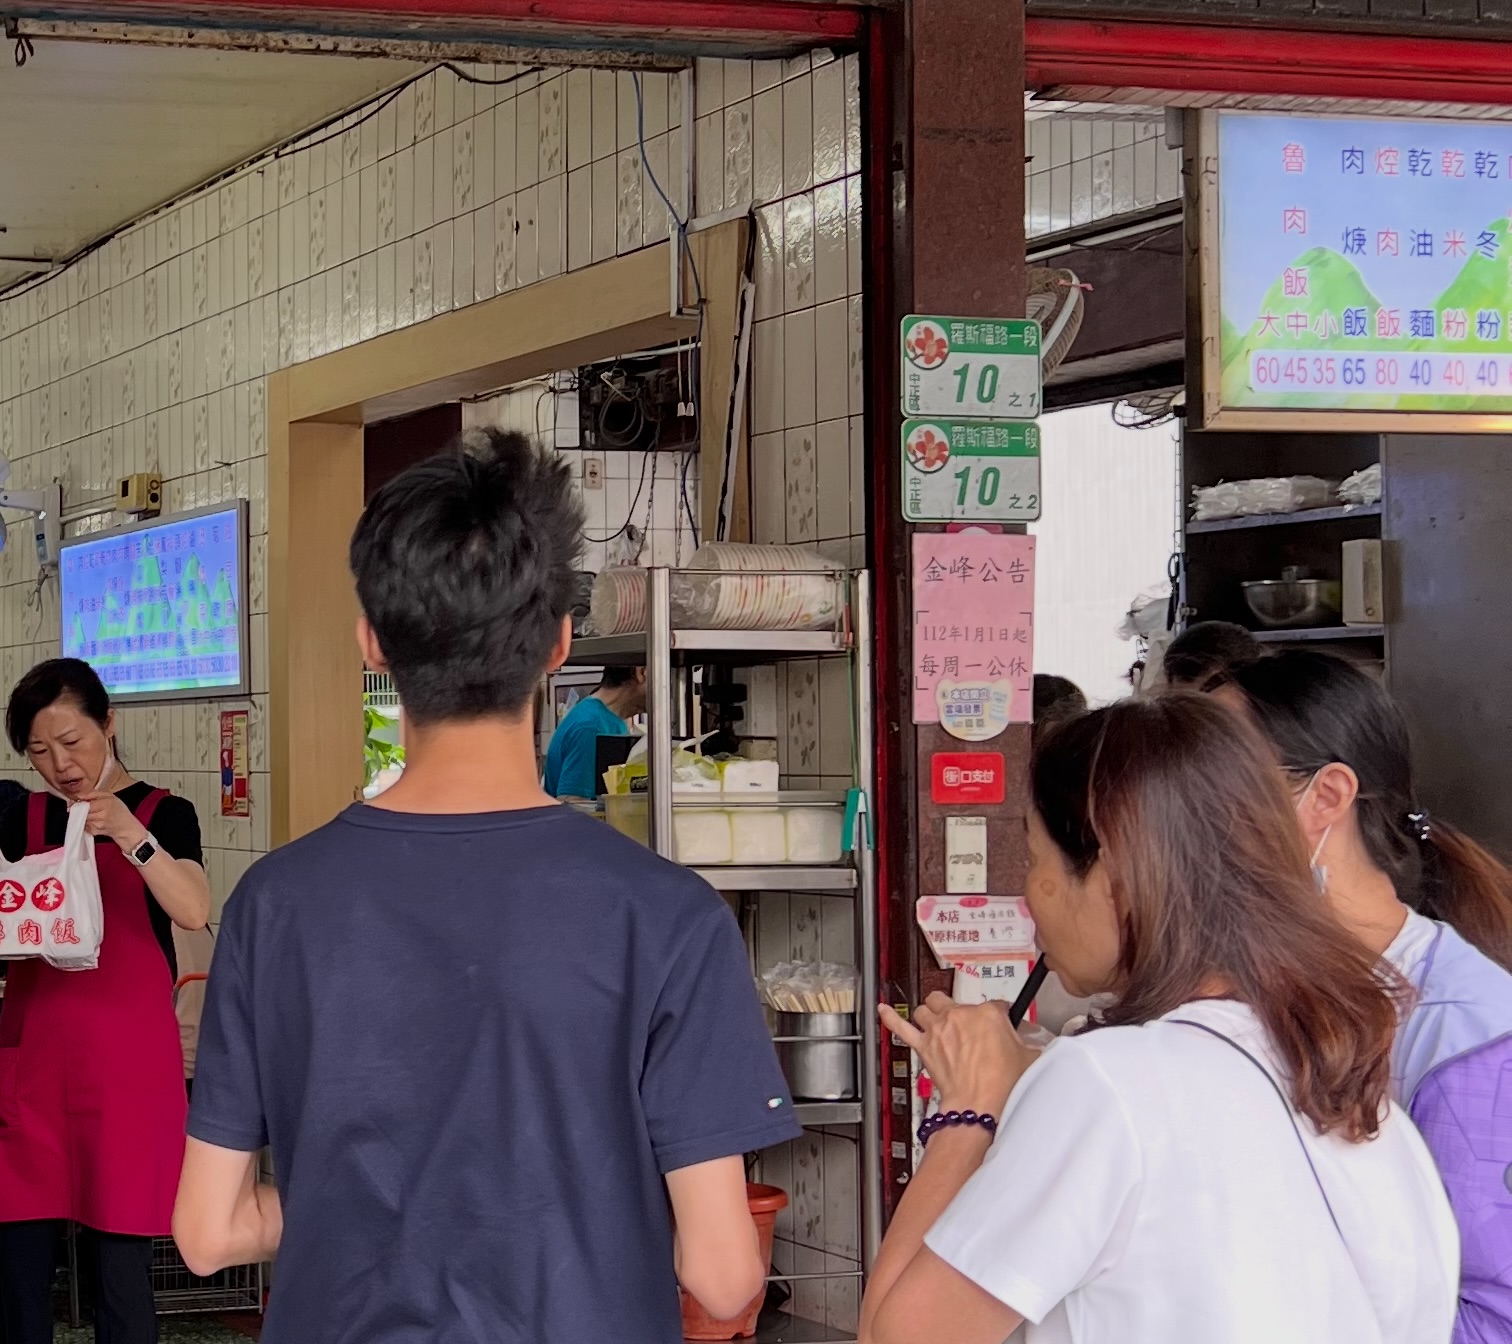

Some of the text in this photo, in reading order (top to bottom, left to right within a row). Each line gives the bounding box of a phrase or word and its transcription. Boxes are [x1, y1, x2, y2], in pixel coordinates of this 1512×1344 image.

[1280, 142, 1310, 298] 魯肉飯
[1406, 148, 1435, 339] 乾油麵
[1440, 149, 1468, 340] 乾米粉
[1473, 149, 1501, 341] 乾冬粉
[950, 322, 1038, 348] 羅斯福路一段
[1257, 310, 1339, 339] 大 中 小
[952, 362, 1037, 408] 10 之1
[1255, 356, 1498, 386] 60 45 35 65 80 40 40 40
[951, 425, 1038, 449] 羅斯福路一段
[953, 465, 1038, 510] 10 之2
[922, 555, 1031, 585] 金峰公告
[922, 624, 1029, 644] 112年1月1日起
[918, 653, 1030, 678] 每周一公休
[935, 910, 960, 924] 本店
